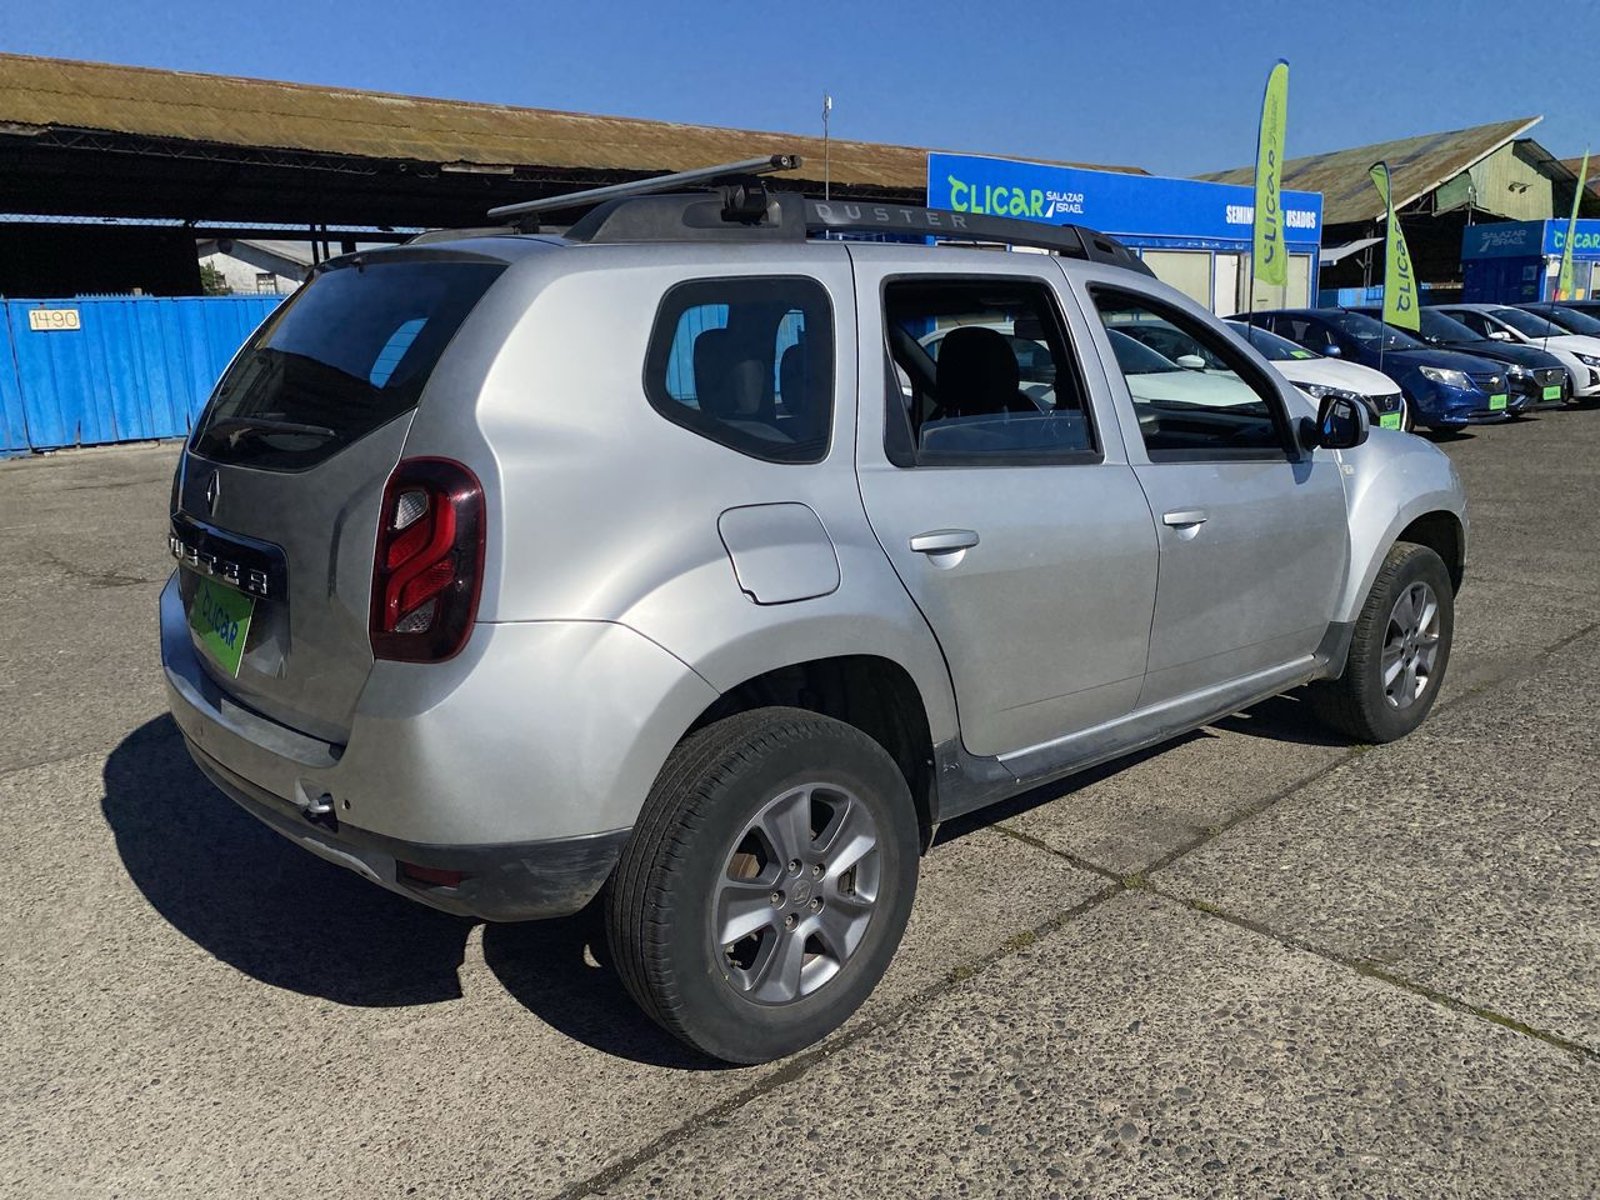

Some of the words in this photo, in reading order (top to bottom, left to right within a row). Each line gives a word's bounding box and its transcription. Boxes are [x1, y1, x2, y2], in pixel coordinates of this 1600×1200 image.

[1046, 190, 1084, 204] SALAZAR
[815, 203, 968, 230] DUSTER
[1056, 202, 1084, 215] ISRAEL
[1286, 210, 1317, 229] USADOS
[33, 311, 78, 328] 1490
